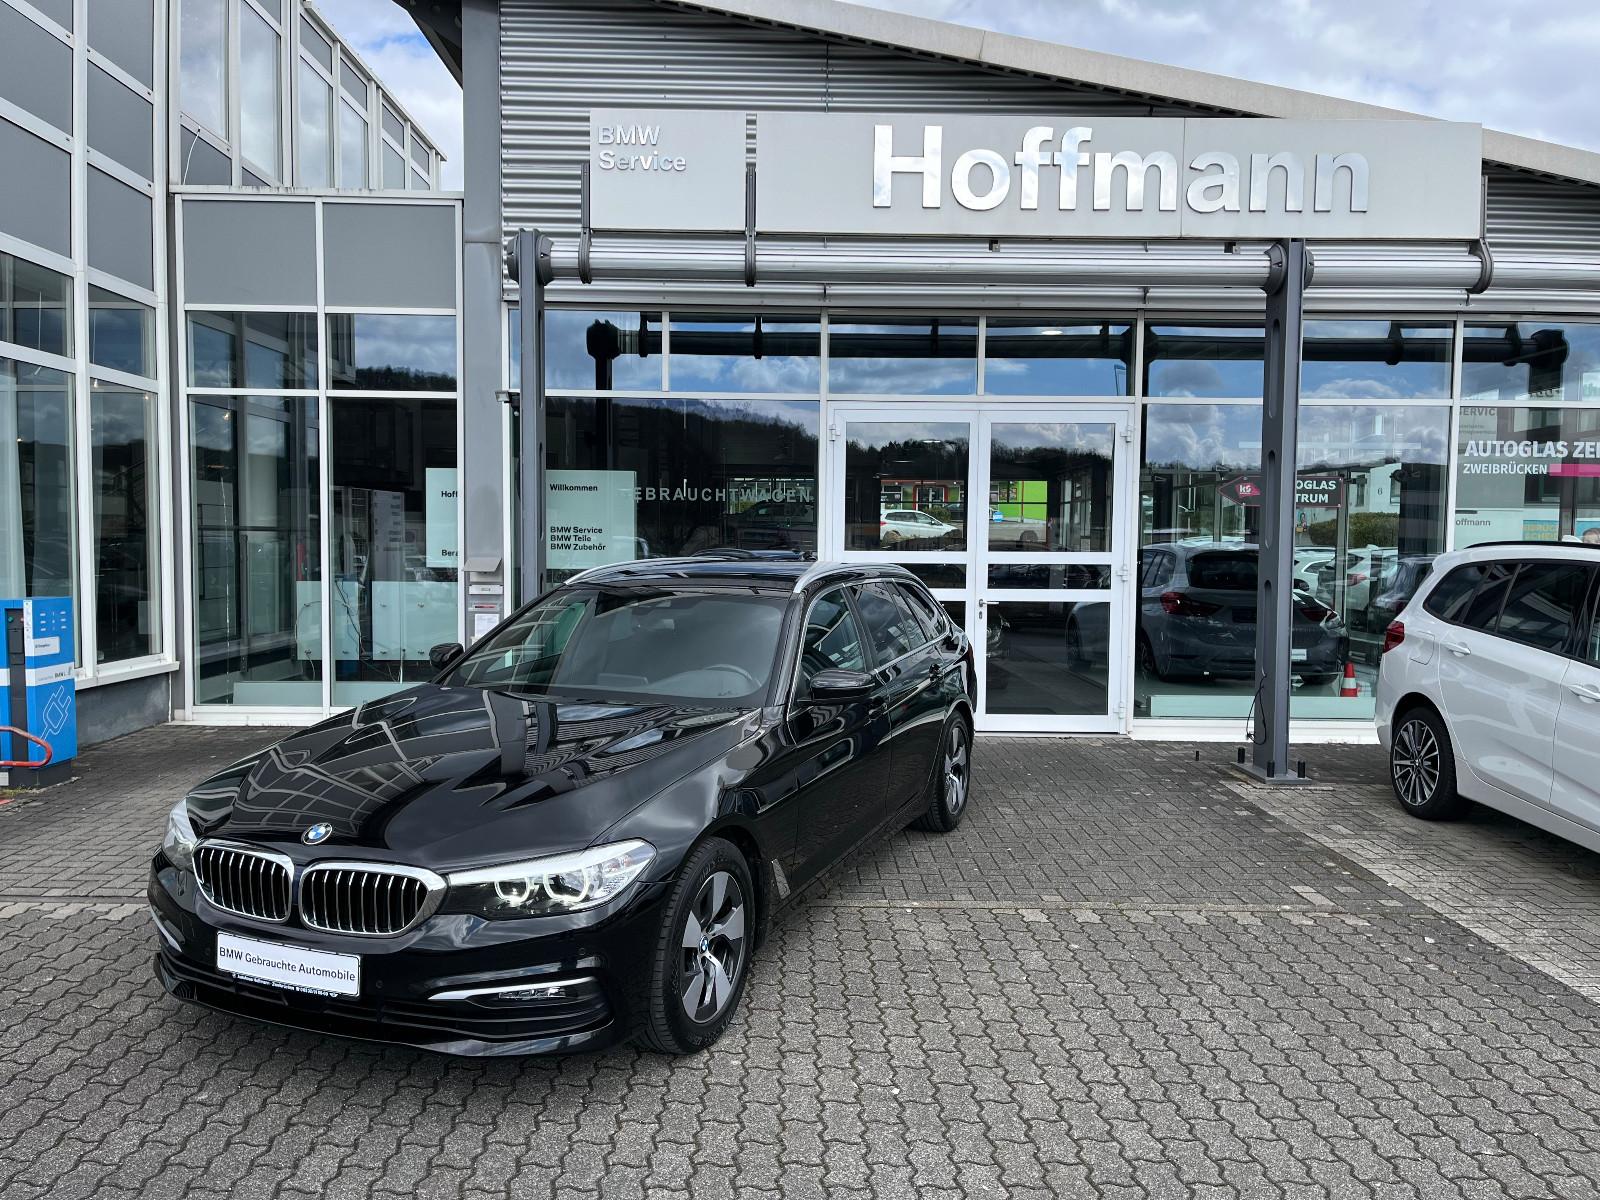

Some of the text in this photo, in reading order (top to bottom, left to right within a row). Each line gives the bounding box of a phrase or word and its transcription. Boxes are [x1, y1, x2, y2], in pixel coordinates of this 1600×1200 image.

[598, 124, 660, 145] BMW
[599, 150, 686, 171] Service
[873, 125, 1370, 213] Hoffmann
[1464, 440, 1569, 458] AUTOGLAS
[1463, 461, 1548, 475] ZWEIBRÜCKEN
[549, 483, 598, 492] Willkommen
[1296, 480, 1337, 490] OGLAS
[631, 486, 811, 503] EBRAUCHTWAGEN
[1296, 493, 1329, 503] TRUM
[1455, 518, 1491, 526] offmann
[550, 526, 603, 534] BMW Service
[550, 534, 571, 542] BMW
[573, 542, 606, 551] Zubehör
[219, 946, 356, 982] BMW Gebrauchte Automobile
